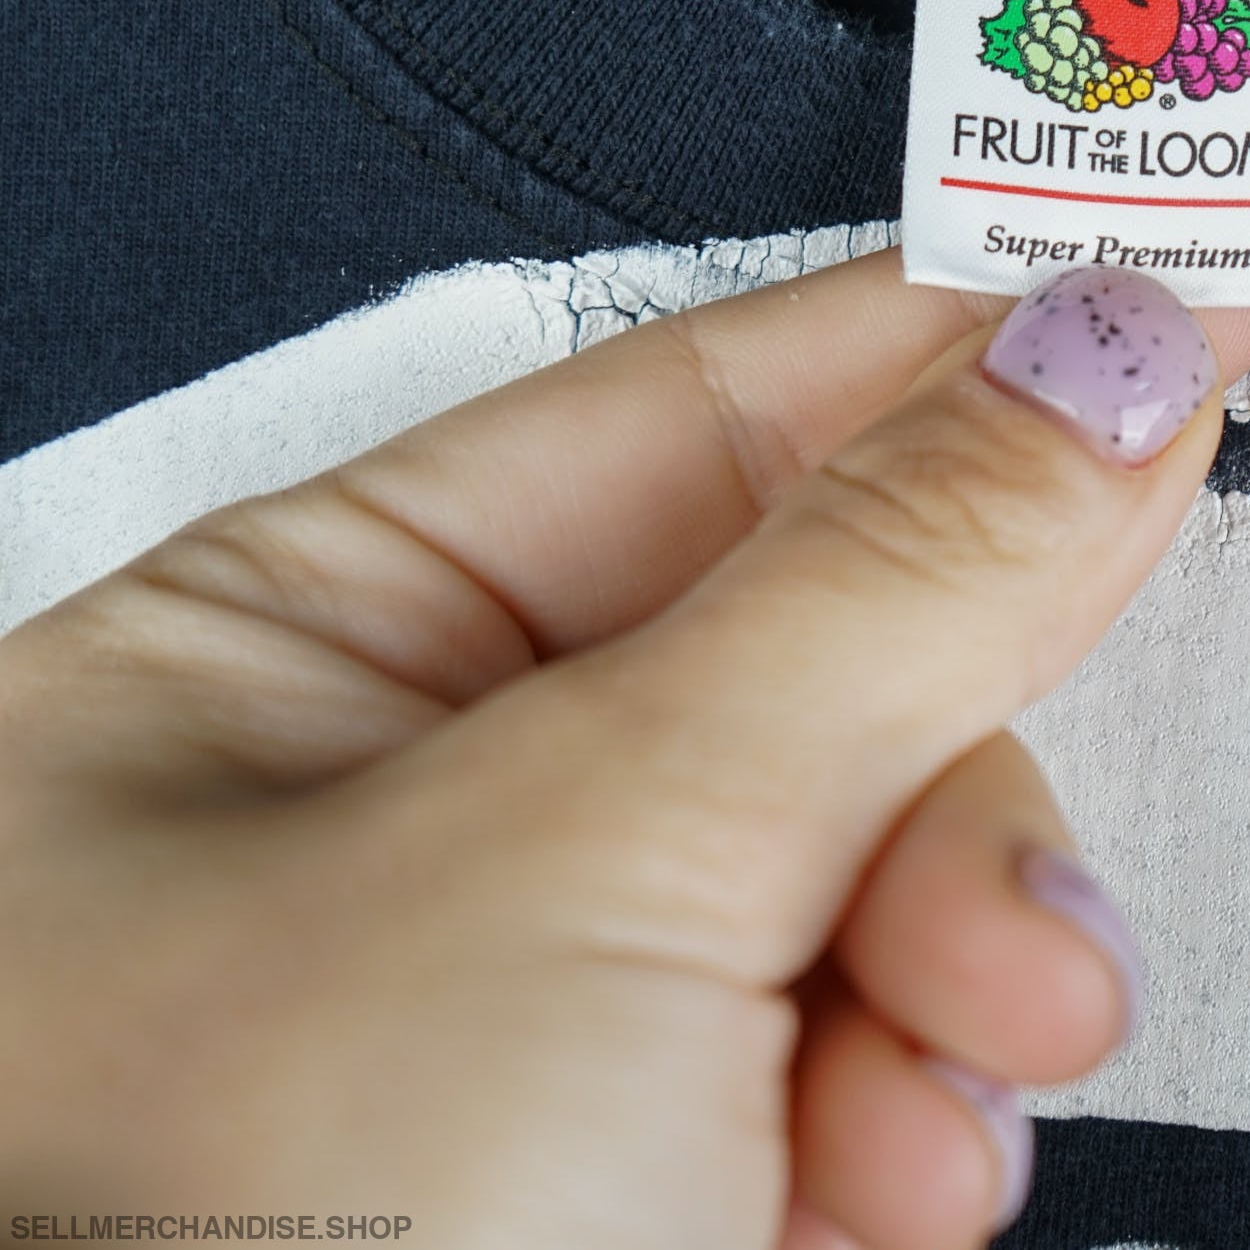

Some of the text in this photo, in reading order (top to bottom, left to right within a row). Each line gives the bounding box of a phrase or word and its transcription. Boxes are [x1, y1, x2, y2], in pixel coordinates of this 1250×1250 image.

[953, 113, 1089, 170] FRUIT
[1095, 129, 1128, 149] OF
[1088, 152, 1130, 175] THE
[984, 225, 1084, 268] Super
